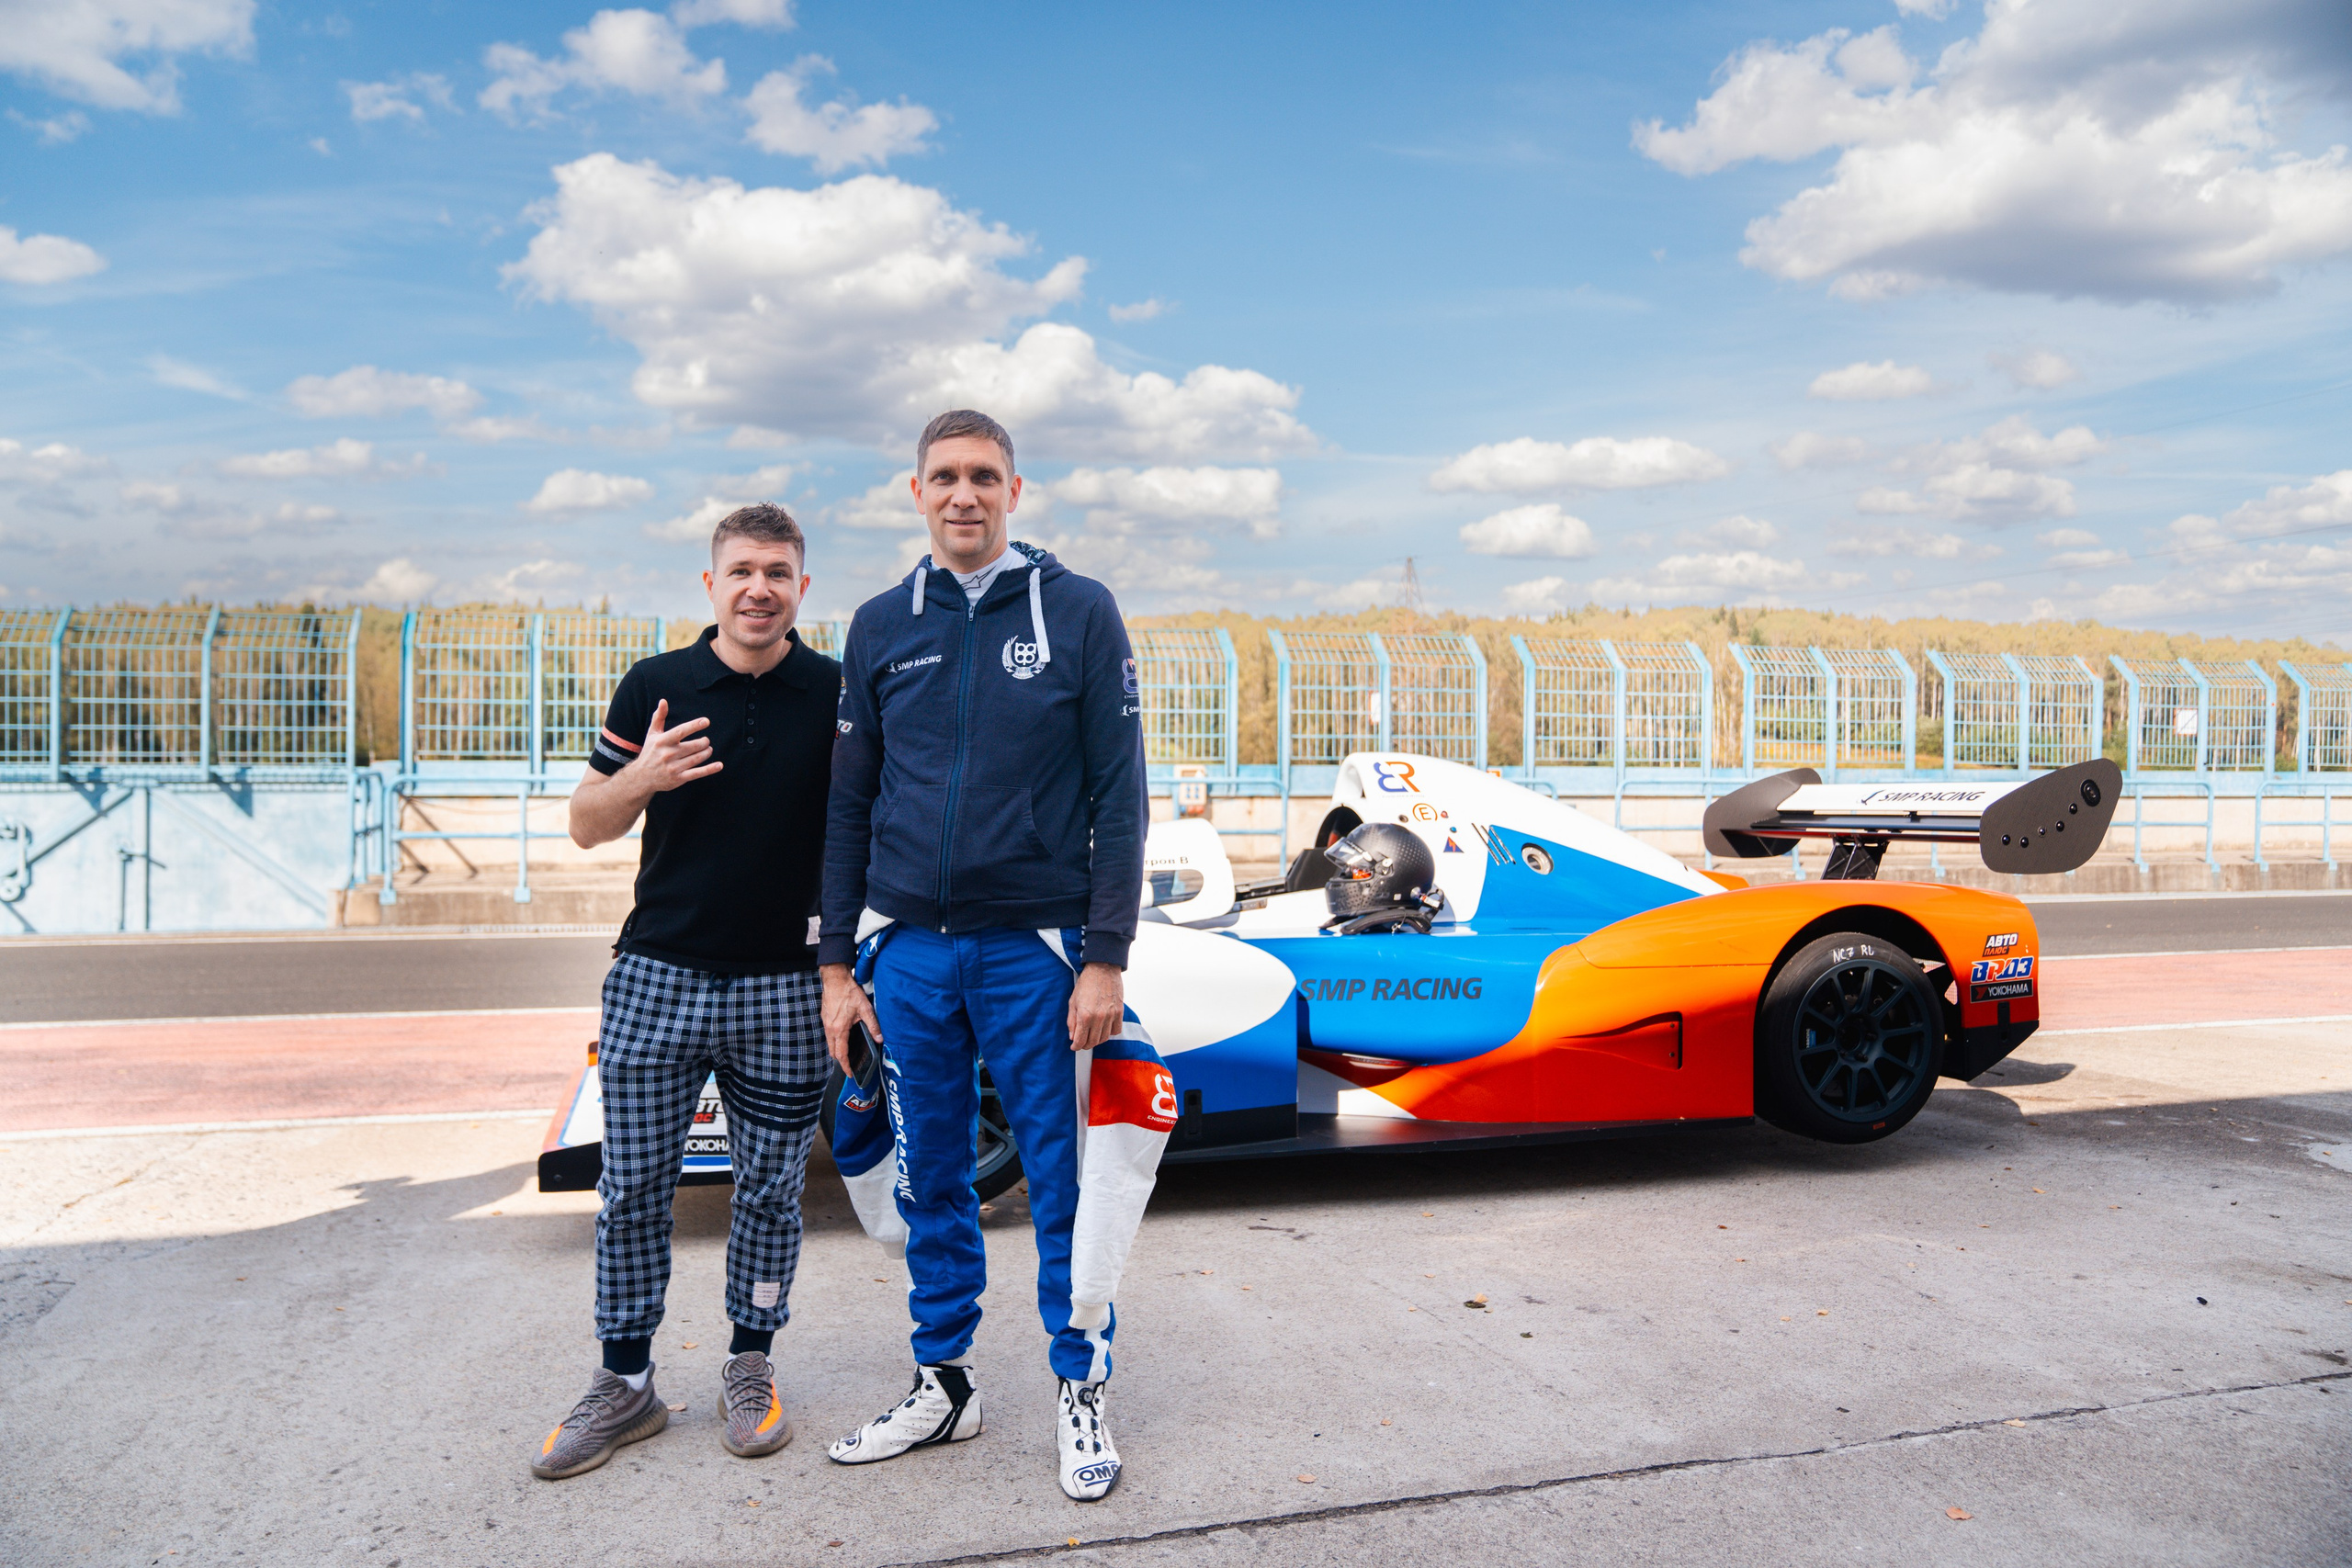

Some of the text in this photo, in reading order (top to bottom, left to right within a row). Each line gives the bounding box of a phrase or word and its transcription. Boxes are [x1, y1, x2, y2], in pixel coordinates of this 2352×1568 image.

[898, 655, 942, 671] SMP RACING
[1878, 791, 1985, 802] SMP RACING
[1985, 932, 2018, 948] АВТО
[1984, 947, 2007, 955] ПЛЮС
[1301, 977, 1482, 1001] SMP RACING
[1988, 983, 2029, 997] YOKOHAMA
[888, 1077, 916, 1203] SMP RACING
